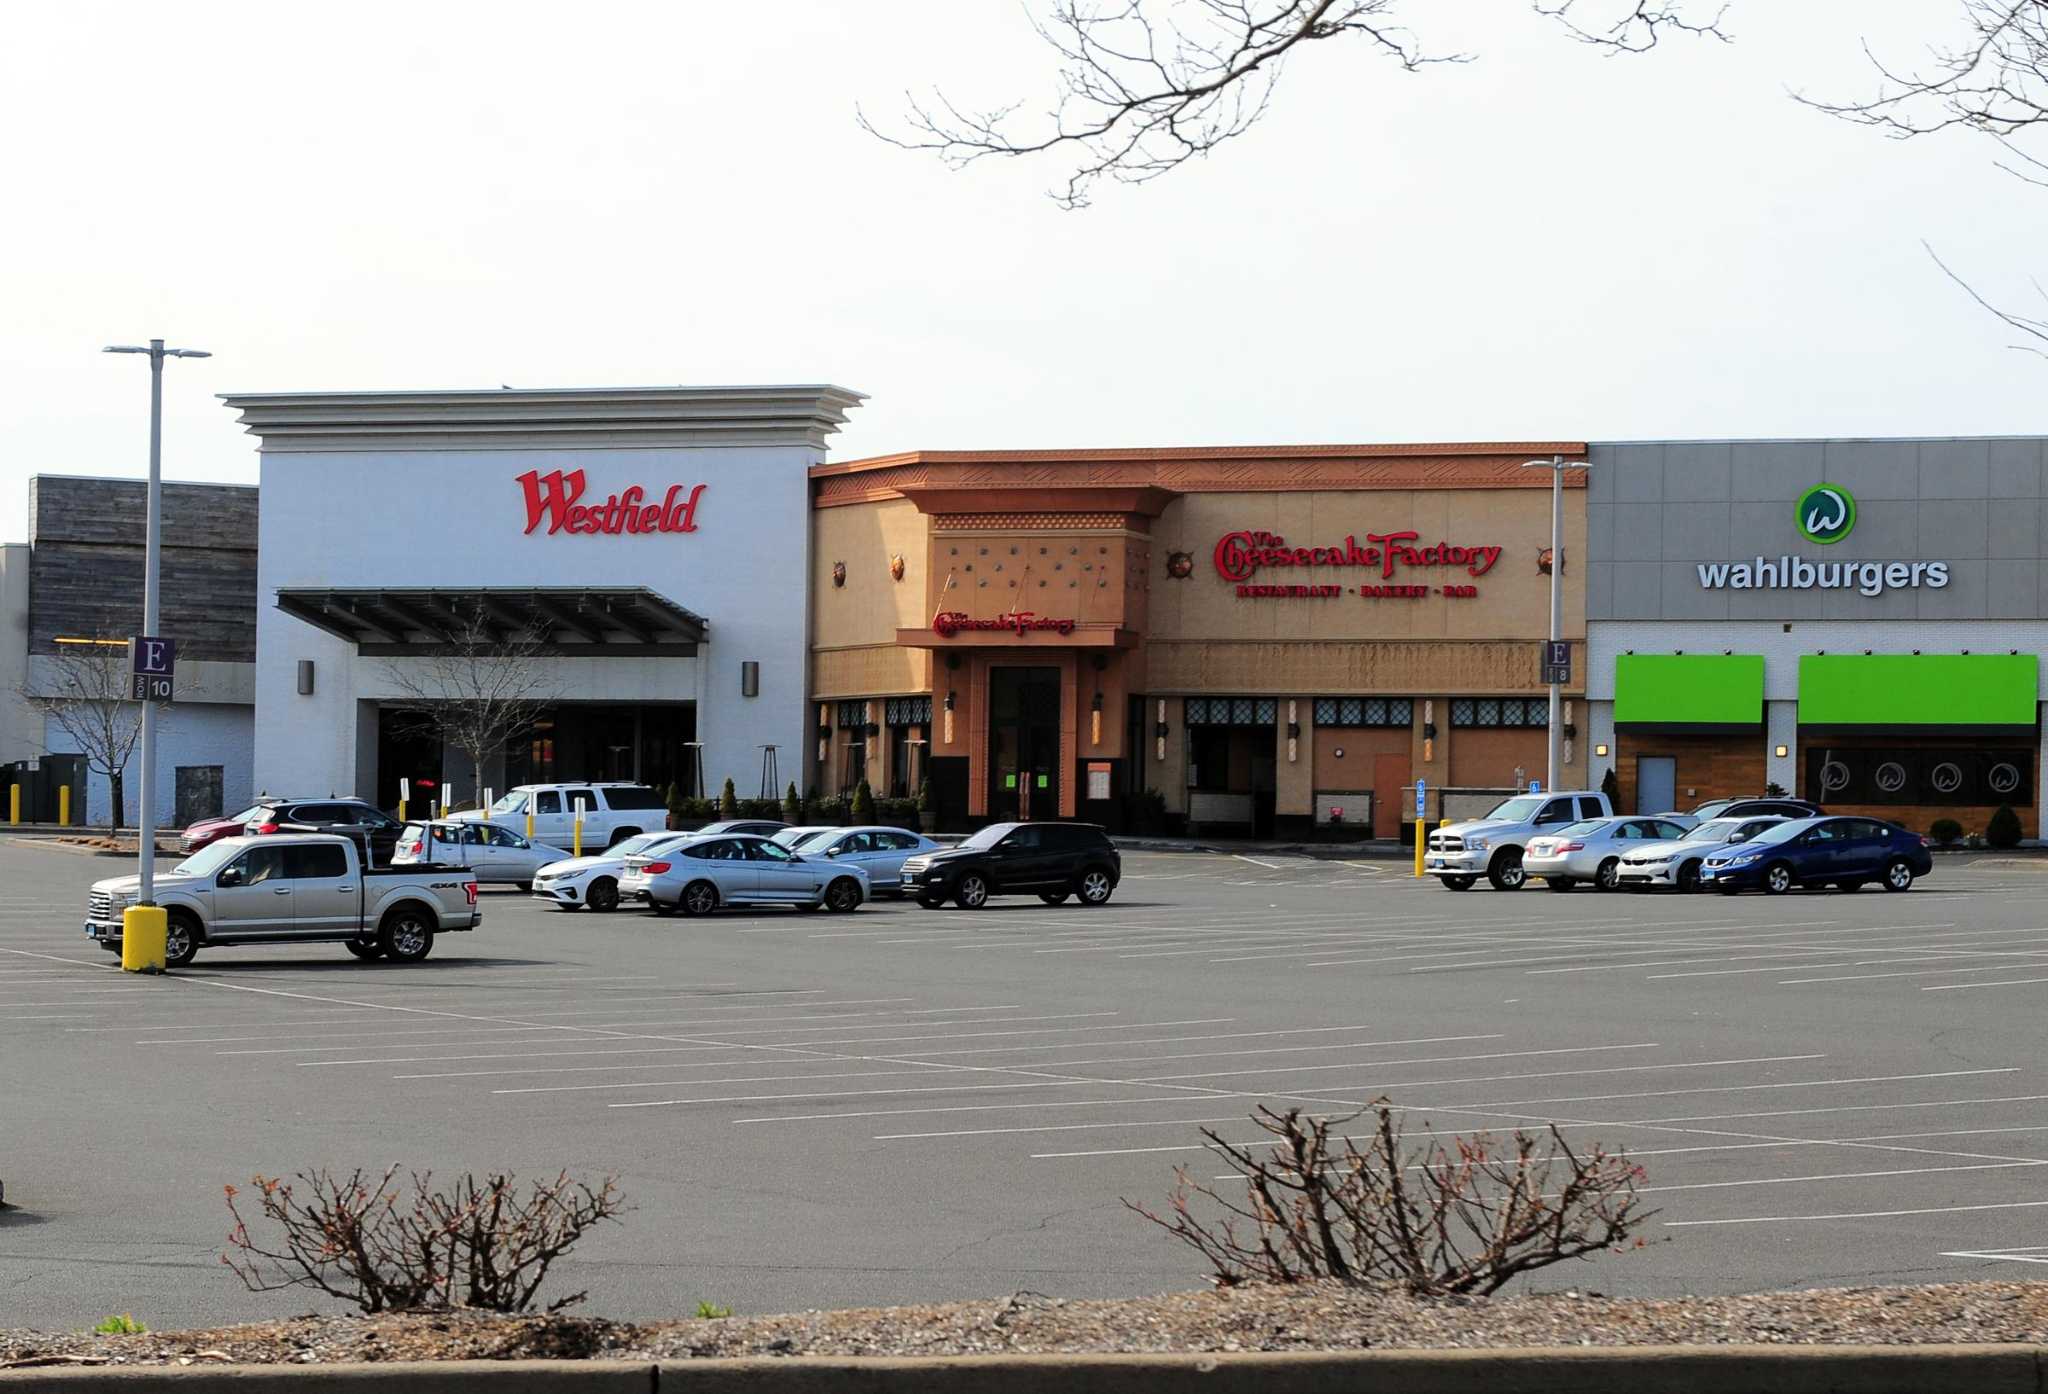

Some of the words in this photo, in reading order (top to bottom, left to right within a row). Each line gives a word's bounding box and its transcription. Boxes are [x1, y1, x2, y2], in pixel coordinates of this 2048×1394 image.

[515, 468, 707, 536] Westfield
[1252, 531, 1284, 547] The
[1214, 530, 1381, 581] Cheesecake
[1366, 530, 1503, 581] Factory
[1696, 555, 1950, 597] wahlburgers
[1235, 584, 1342, 599] RESTAURANT
[1359, 584, 1429, 599] BAKERY
[1442, 584, 1478, 599] BAR
[143, 641, 167, 672] E
[1552, 643, 1567, 664] E
[151, 680, 170, 697] 10
